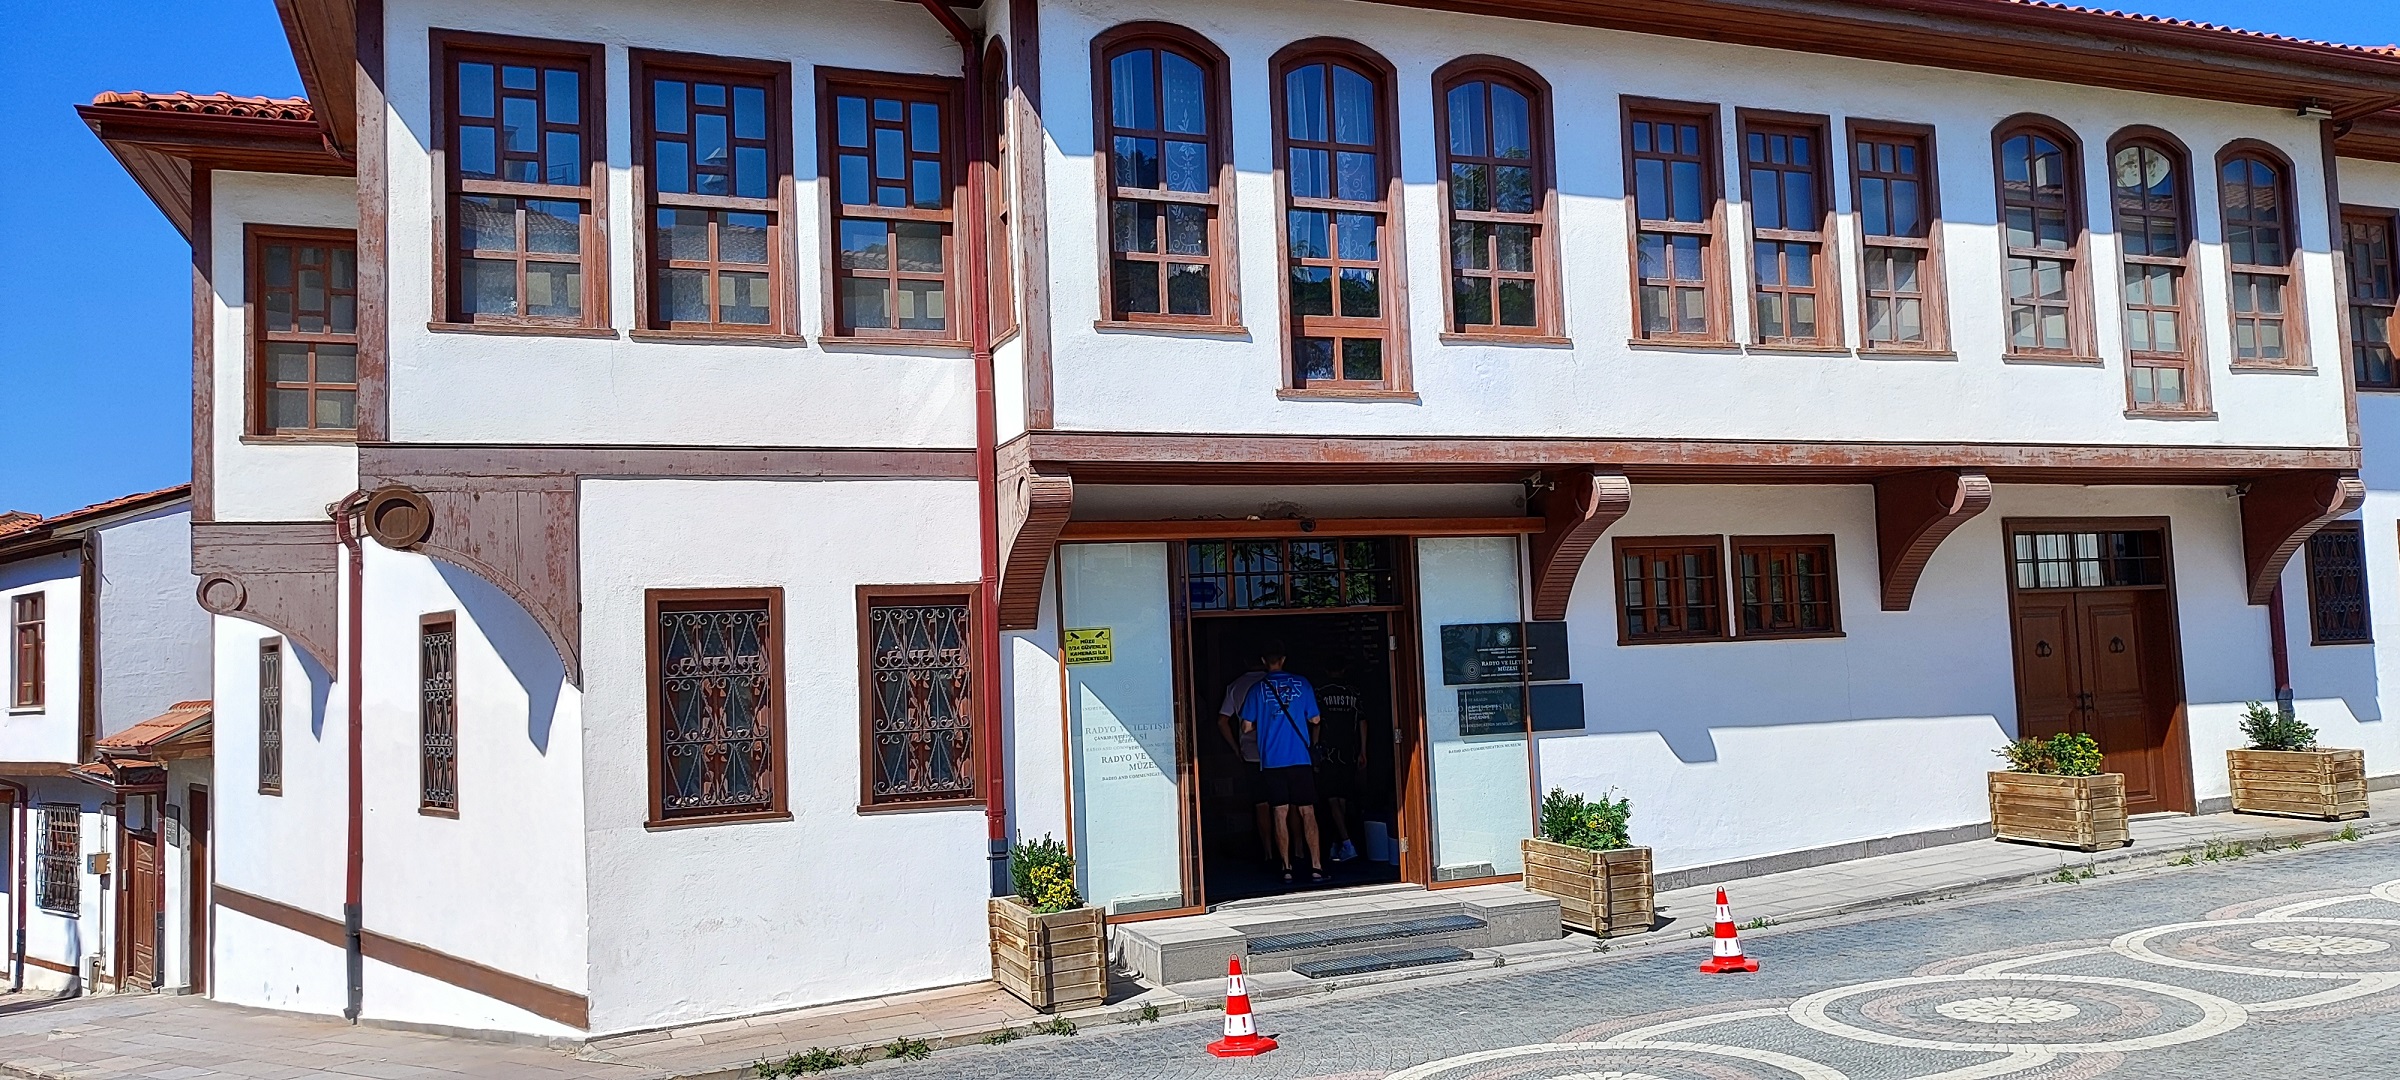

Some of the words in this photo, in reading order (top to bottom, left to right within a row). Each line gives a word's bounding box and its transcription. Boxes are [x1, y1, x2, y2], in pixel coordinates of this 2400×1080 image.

[1323, 695, 1357, 706] TRAPST
[1085, 725, 1117, 735] RADYO
[1101, 754, 1132, 763] RADYO
[1134, 752, 1147, 760] VE
